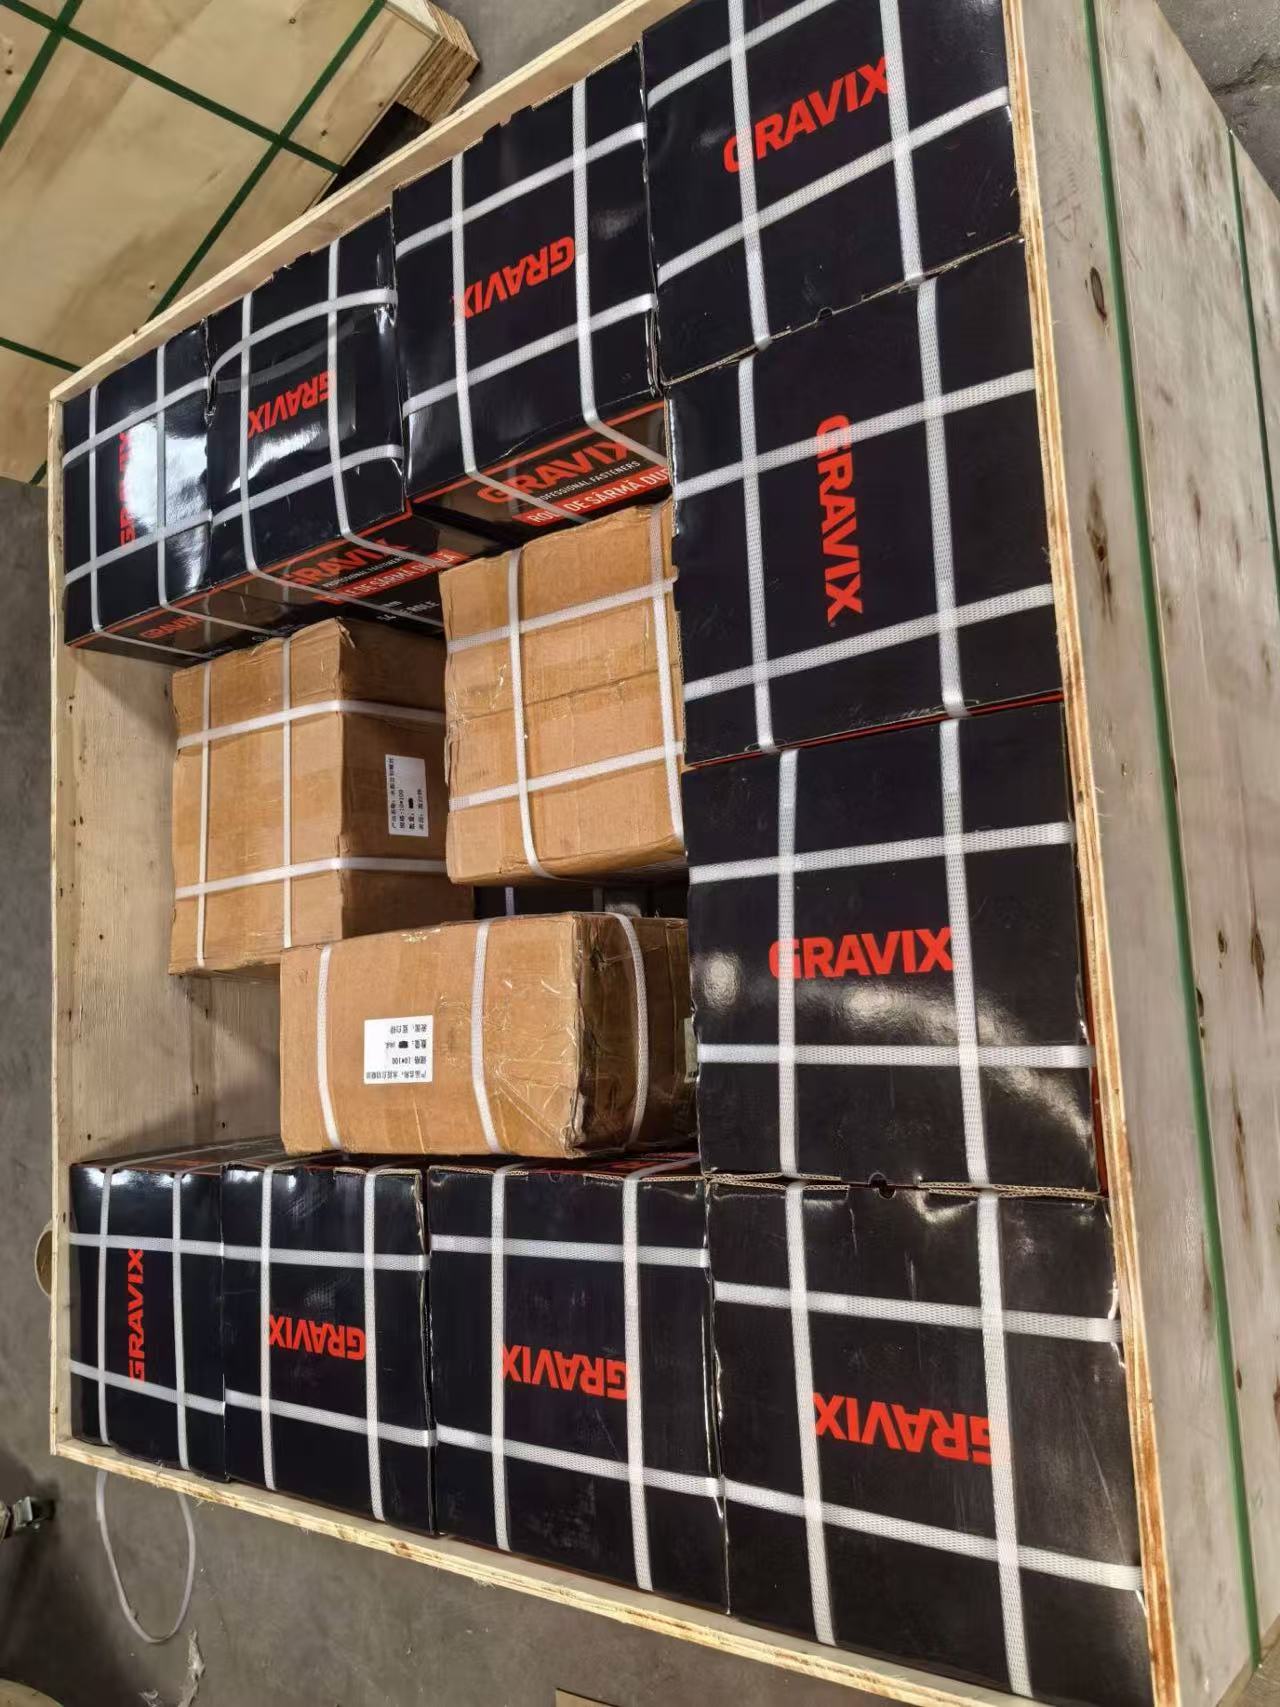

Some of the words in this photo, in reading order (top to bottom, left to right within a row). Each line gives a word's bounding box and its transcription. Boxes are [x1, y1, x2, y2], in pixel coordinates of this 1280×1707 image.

[563, 499, 591, 512] DE
[640, 468, 669, 486] DU
[768, 926, 955, 980] GRAVIX
[128, 1249, 145, 1383] GRAVIX
[268, 1313, 366, 1361] GRAVIX
[502, 1344, 628, 1401] GRAVIX
[814, 1391, 993, 1467] GRAVIX
